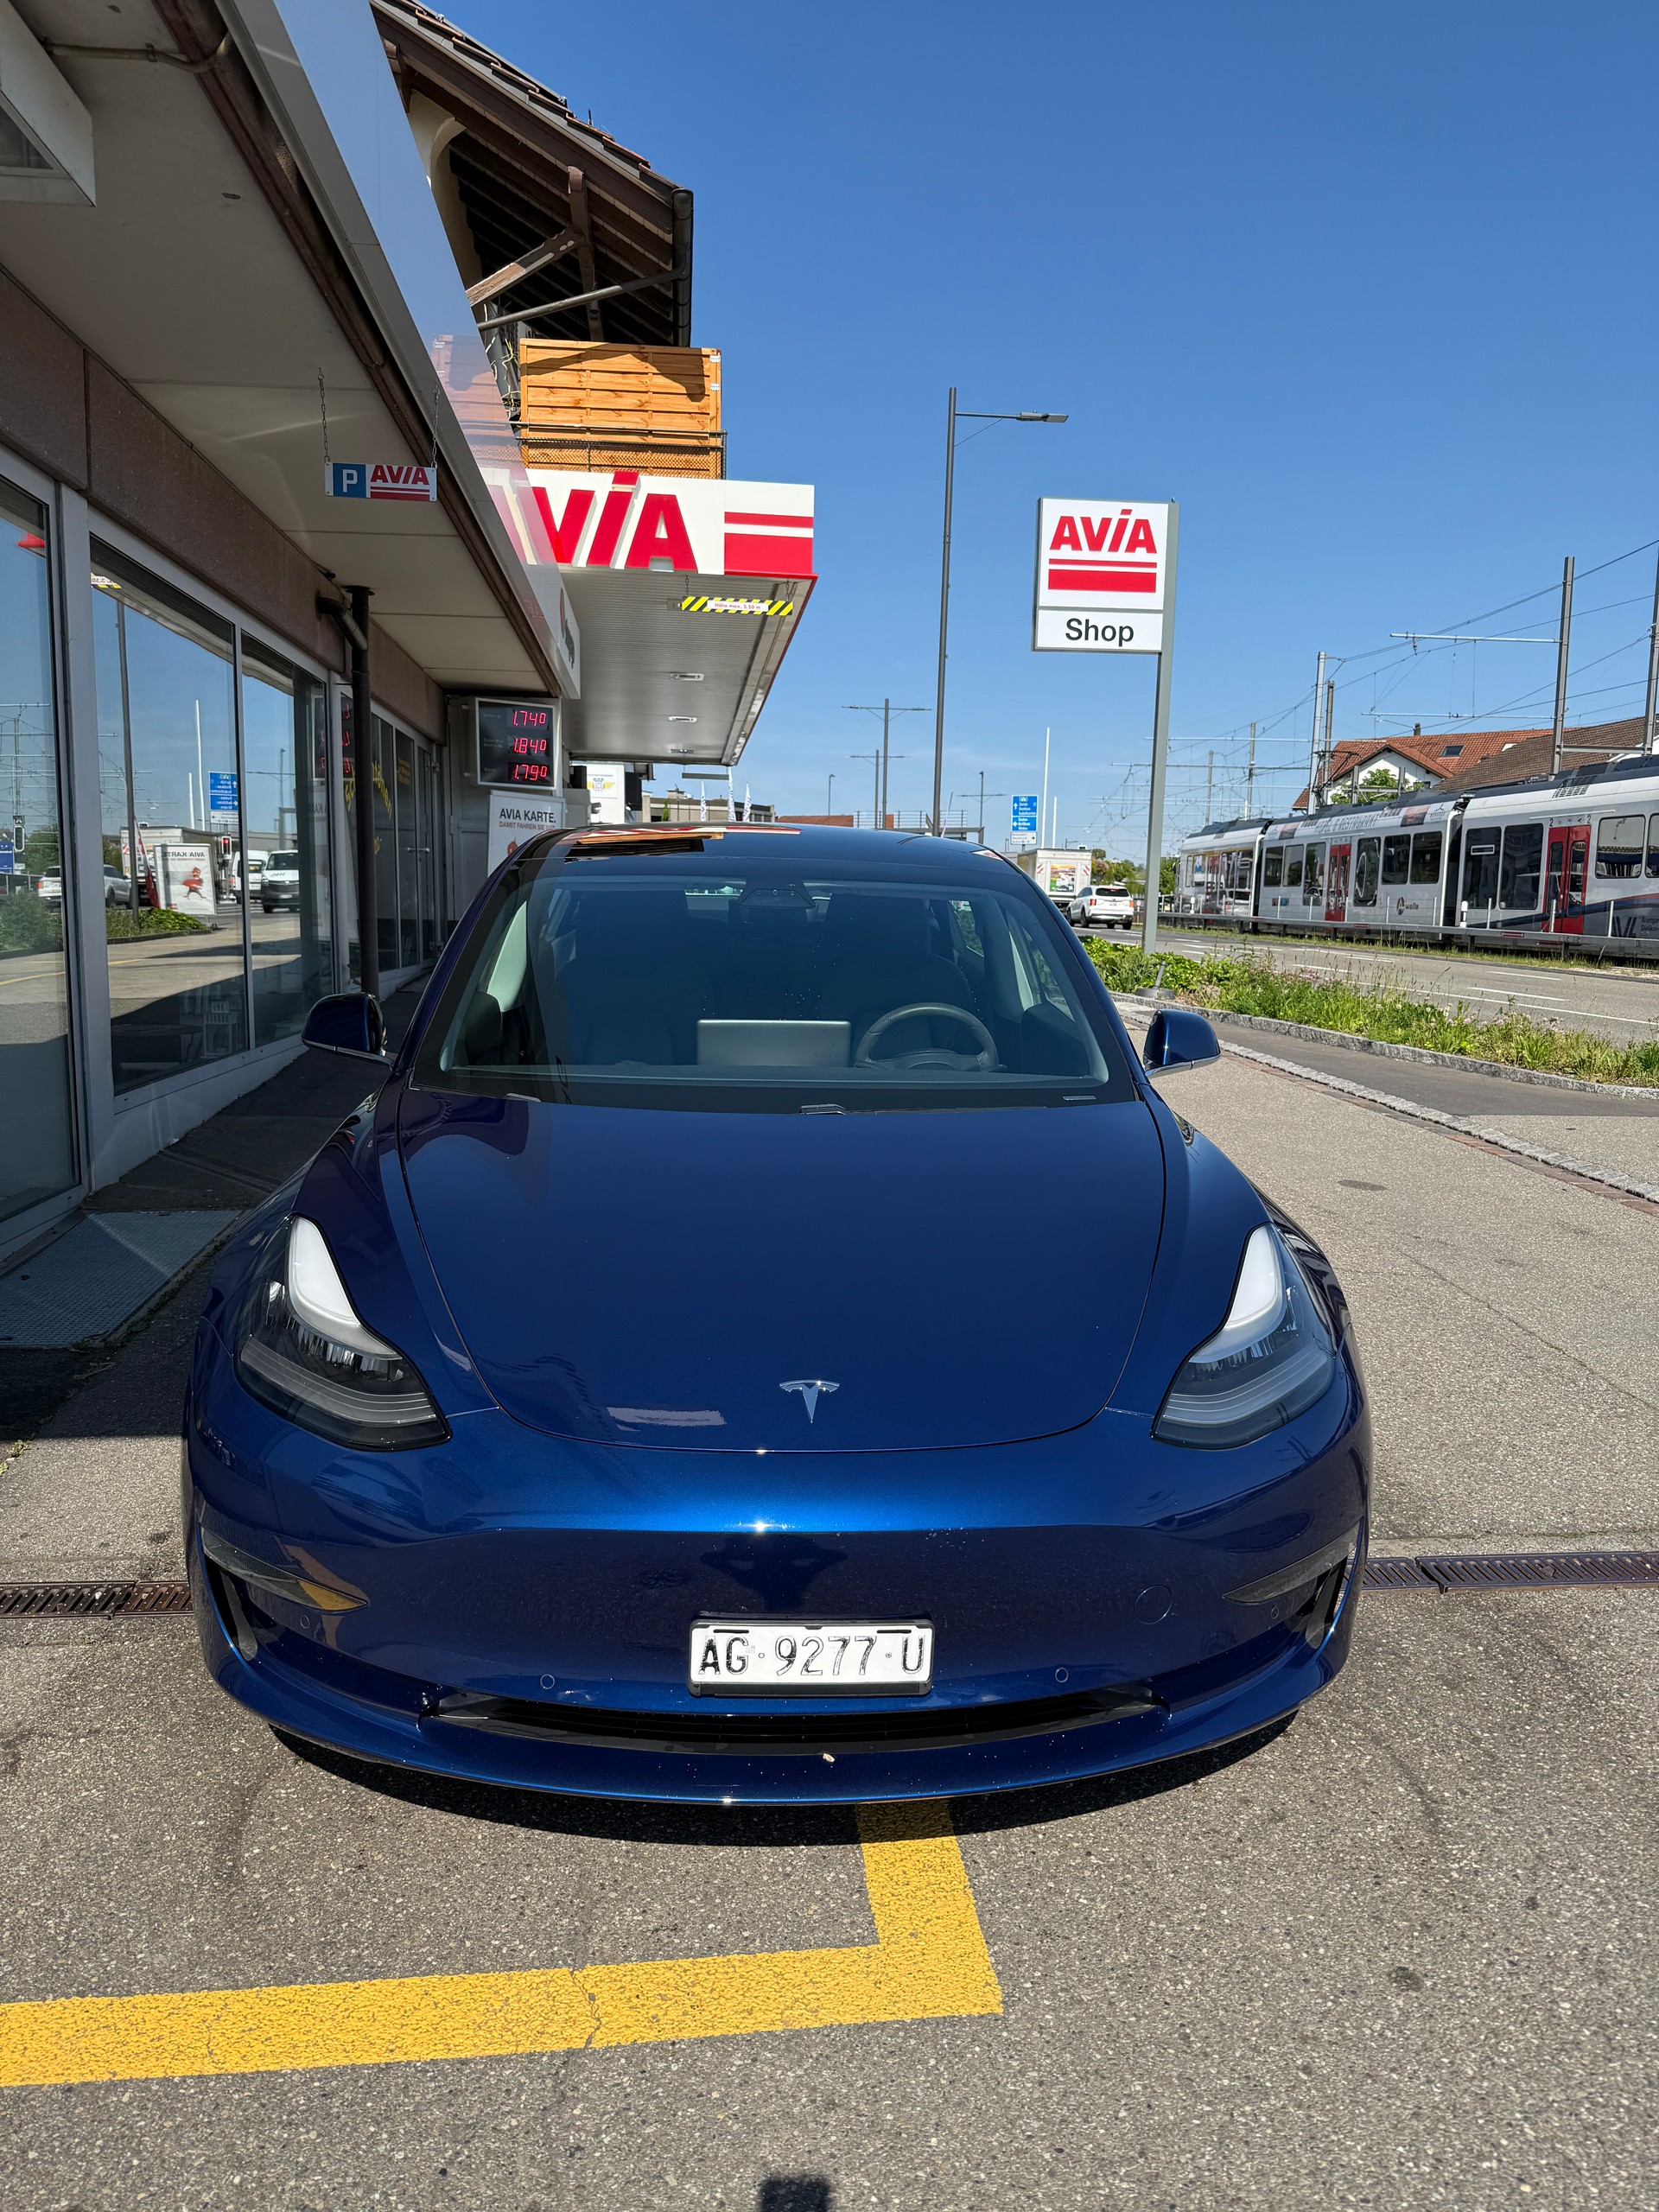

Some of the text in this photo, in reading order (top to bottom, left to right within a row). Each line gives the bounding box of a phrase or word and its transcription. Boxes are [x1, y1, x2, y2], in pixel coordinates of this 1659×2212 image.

[342, 469, 358, 493] P
[370, 464, 430, 485] AVIA
[1049, 509, 1158, 555] AVIA
[1065, 618, 1135, 647] Shop
[499, 808, 556, 823] AVIA KARTE.
[697, 1634, 925, 1676] AG 9277 U
